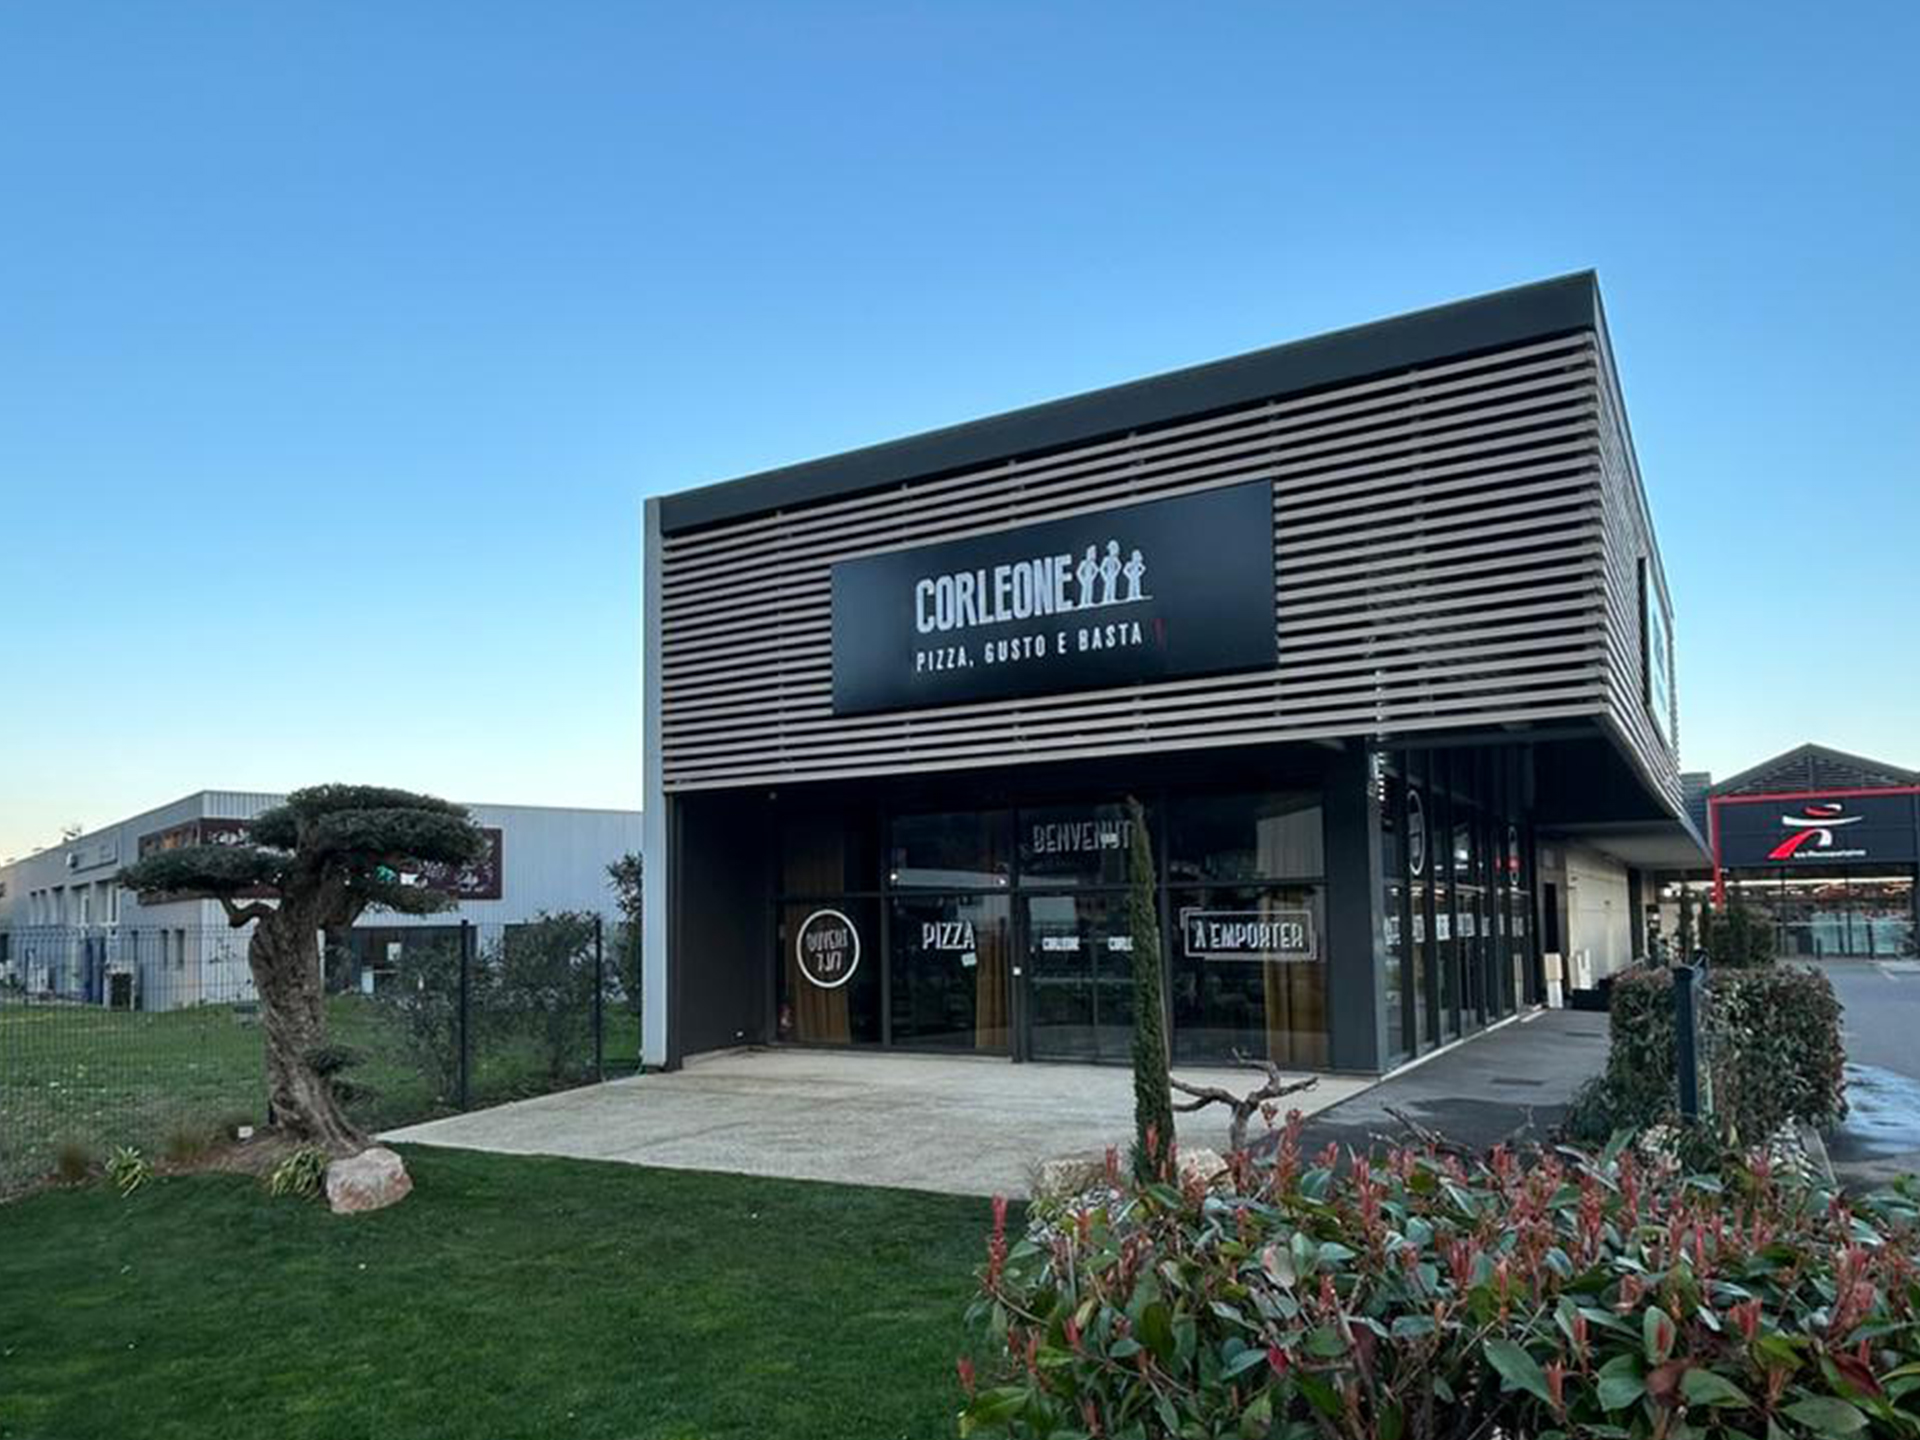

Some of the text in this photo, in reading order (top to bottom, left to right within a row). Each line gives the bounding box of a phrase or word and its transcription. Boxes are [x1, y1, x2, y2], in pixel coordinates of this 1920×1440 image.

[916, 554, 1073, 633] CORLEONE
[916, 645, 974, 672] PIZZA,
[984, 634, 1046, 663] GUSTO
[1057, 631, 1067, 654] E
[1078, 621, 1142, 651] BASTA
[1033, 820, 1133, 853] BENVENUT
[922, 920, 975, 949] PIZZA
[1210, 922, 1303, 948] EMPORTER
